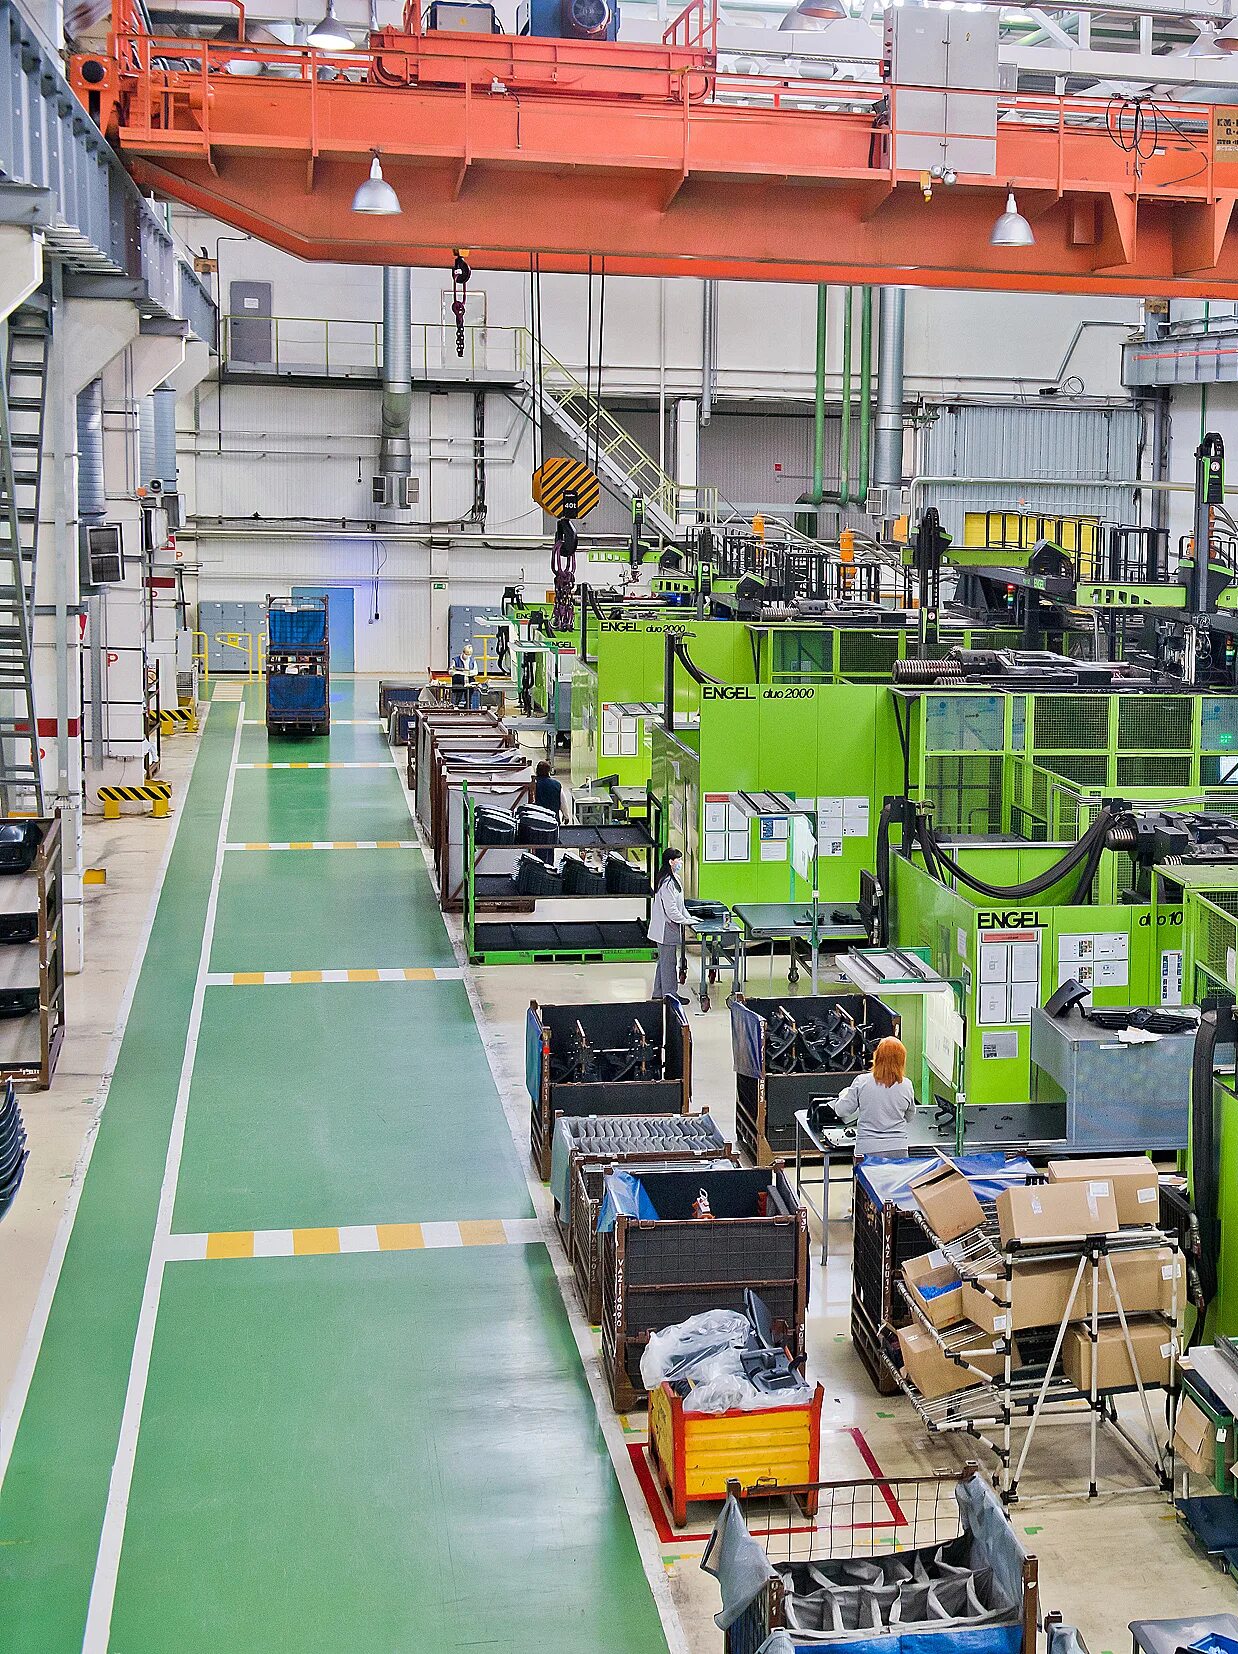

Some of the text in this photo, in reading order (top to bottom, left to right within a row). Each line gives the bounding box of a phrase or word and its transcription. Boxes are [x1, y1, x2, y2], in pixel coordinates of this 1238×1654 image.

[601, 622, 686, 633] ENGEL duo 2000
[703, 687, 815, 700] ENGEL duo 2000
[977, 911, 1049, 929] ENGEL
[771, 1581, 779, 1617] 011
